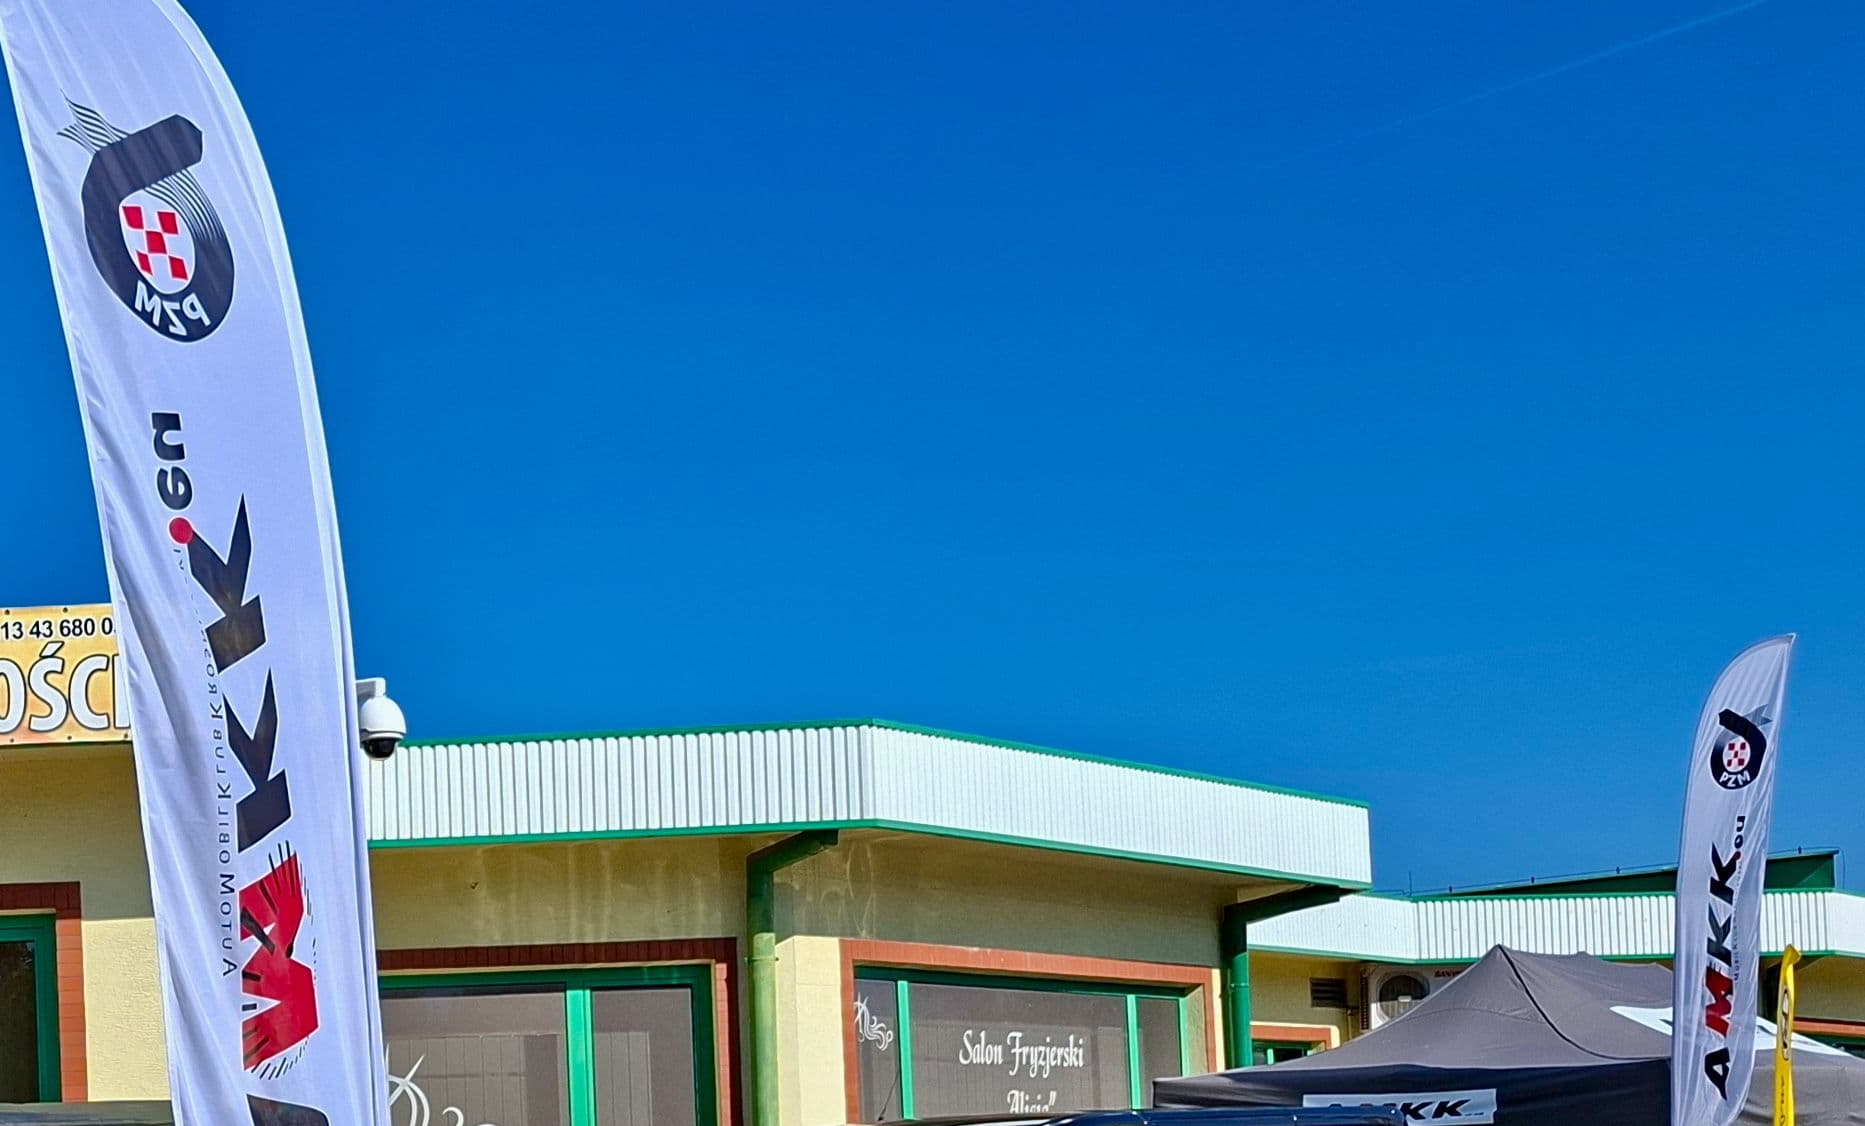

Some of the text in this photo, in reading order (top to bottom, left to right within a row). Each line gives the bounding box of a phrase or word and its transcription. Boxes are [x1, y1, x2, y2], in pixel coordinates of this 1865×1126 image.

[29, 619, 53, 639] 43
[59, 617, 96, 638] 680
[101, 616, 116, 636] 0
[1719, 770, 1751, 787] PZM
[959, 1029, 1084, 1079] Salon Fryzjerski
